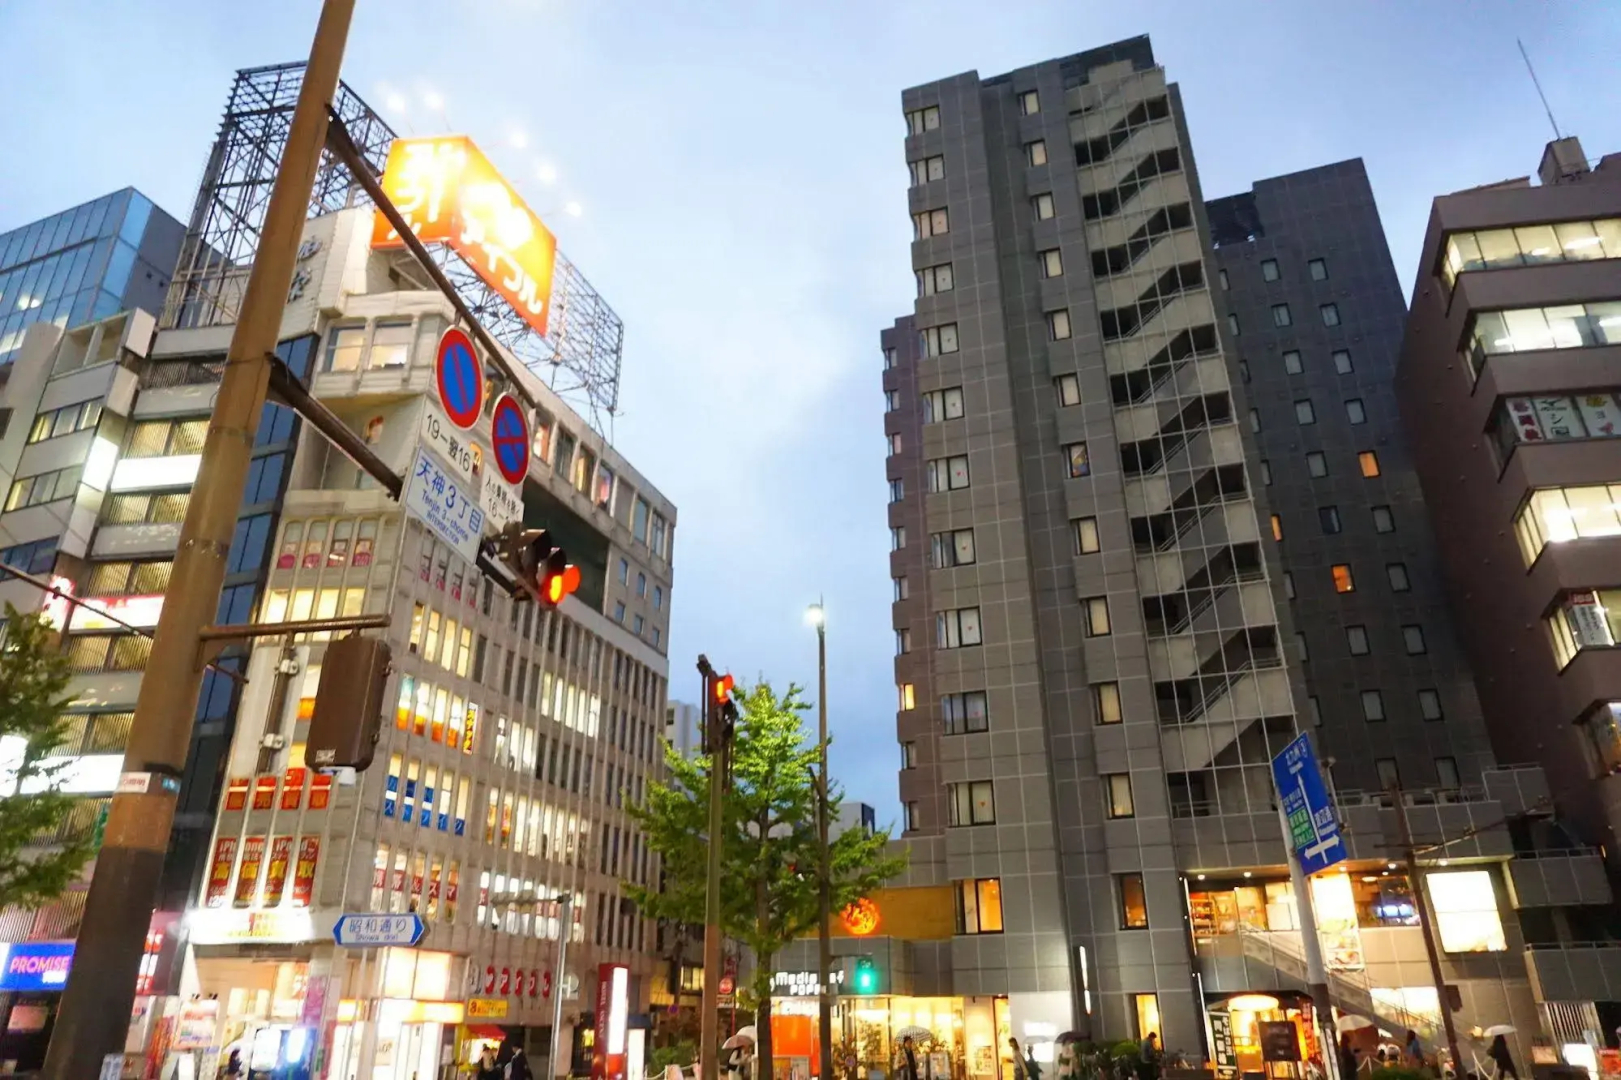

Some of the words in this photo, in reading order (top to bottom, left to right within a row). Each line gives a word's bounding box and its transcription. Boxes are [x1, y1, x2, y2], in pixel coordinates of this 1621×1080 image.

[416, 456, 481, 534] 天神3丁目
[422, 489, 440, 513] Tenjin
[426, 511, 460, 545] INTERSECTION
[214, 861, 315, 879] 高価買取
[350, 918, 407, 933] 昭和通り
[9, 956, 71, 974] PROMISE
